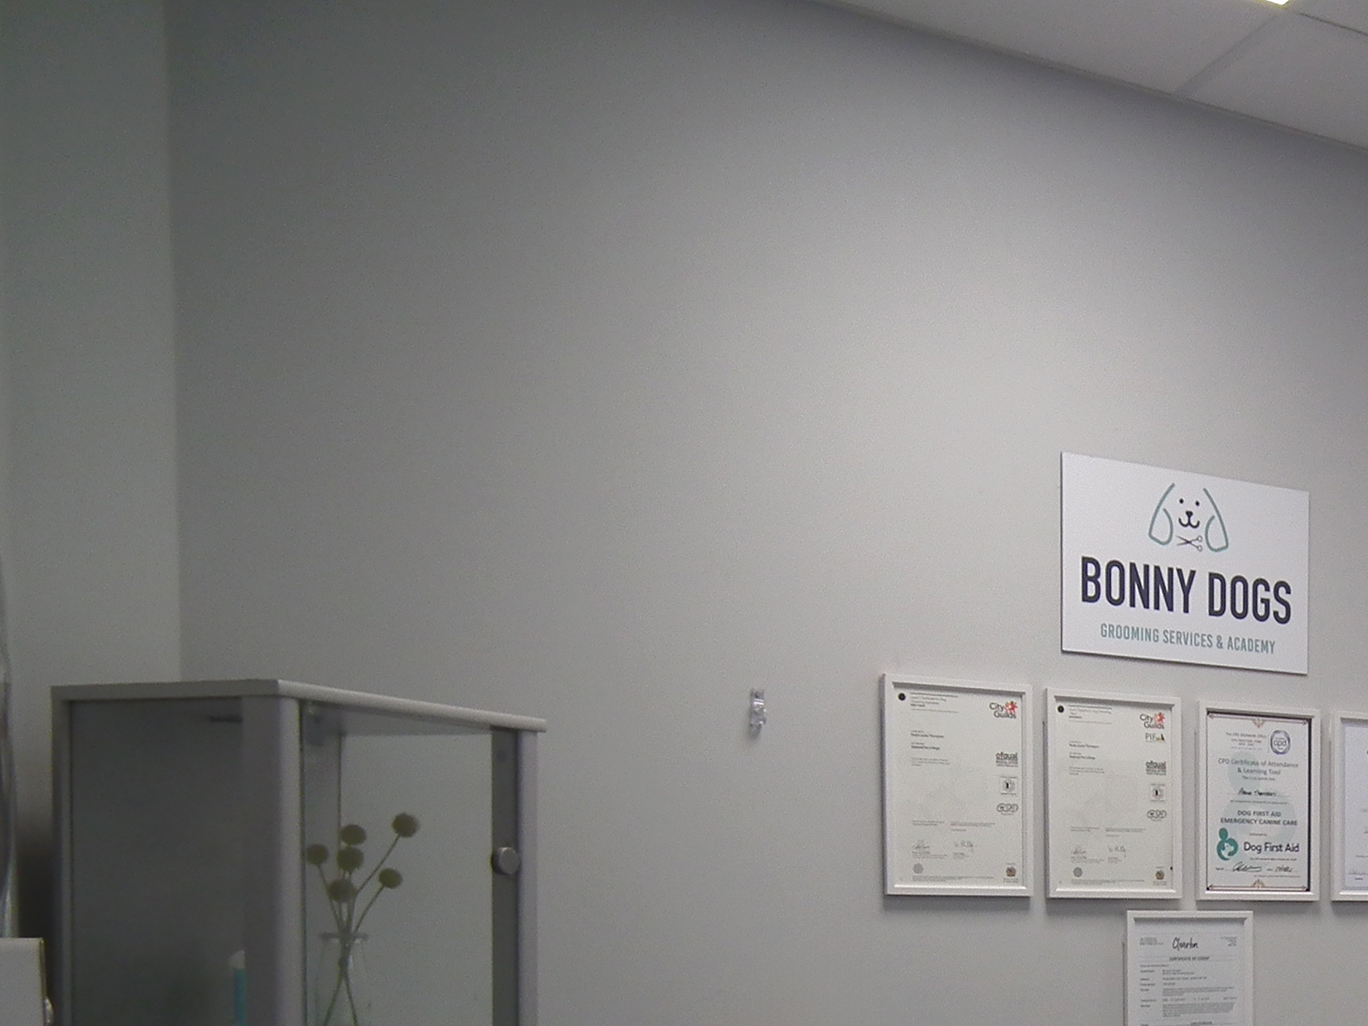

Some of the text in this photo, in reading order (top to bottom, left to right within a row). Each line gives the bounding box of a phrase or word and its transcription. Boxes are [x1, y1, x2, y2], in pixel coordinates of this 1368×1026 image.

[1081, 556, 1292, 625] BONNY DOGS
[1100, 623, 1276, 654] GROOMING SERVICES & ACADEMY
[989, 702, 1005, 713] City
[1140, 713, 1154, 724] City
[1220, 817, 1298, 827] EMERGENCY CANINE CARE
[1243, 841, 1300, 854] Dog First Aid
